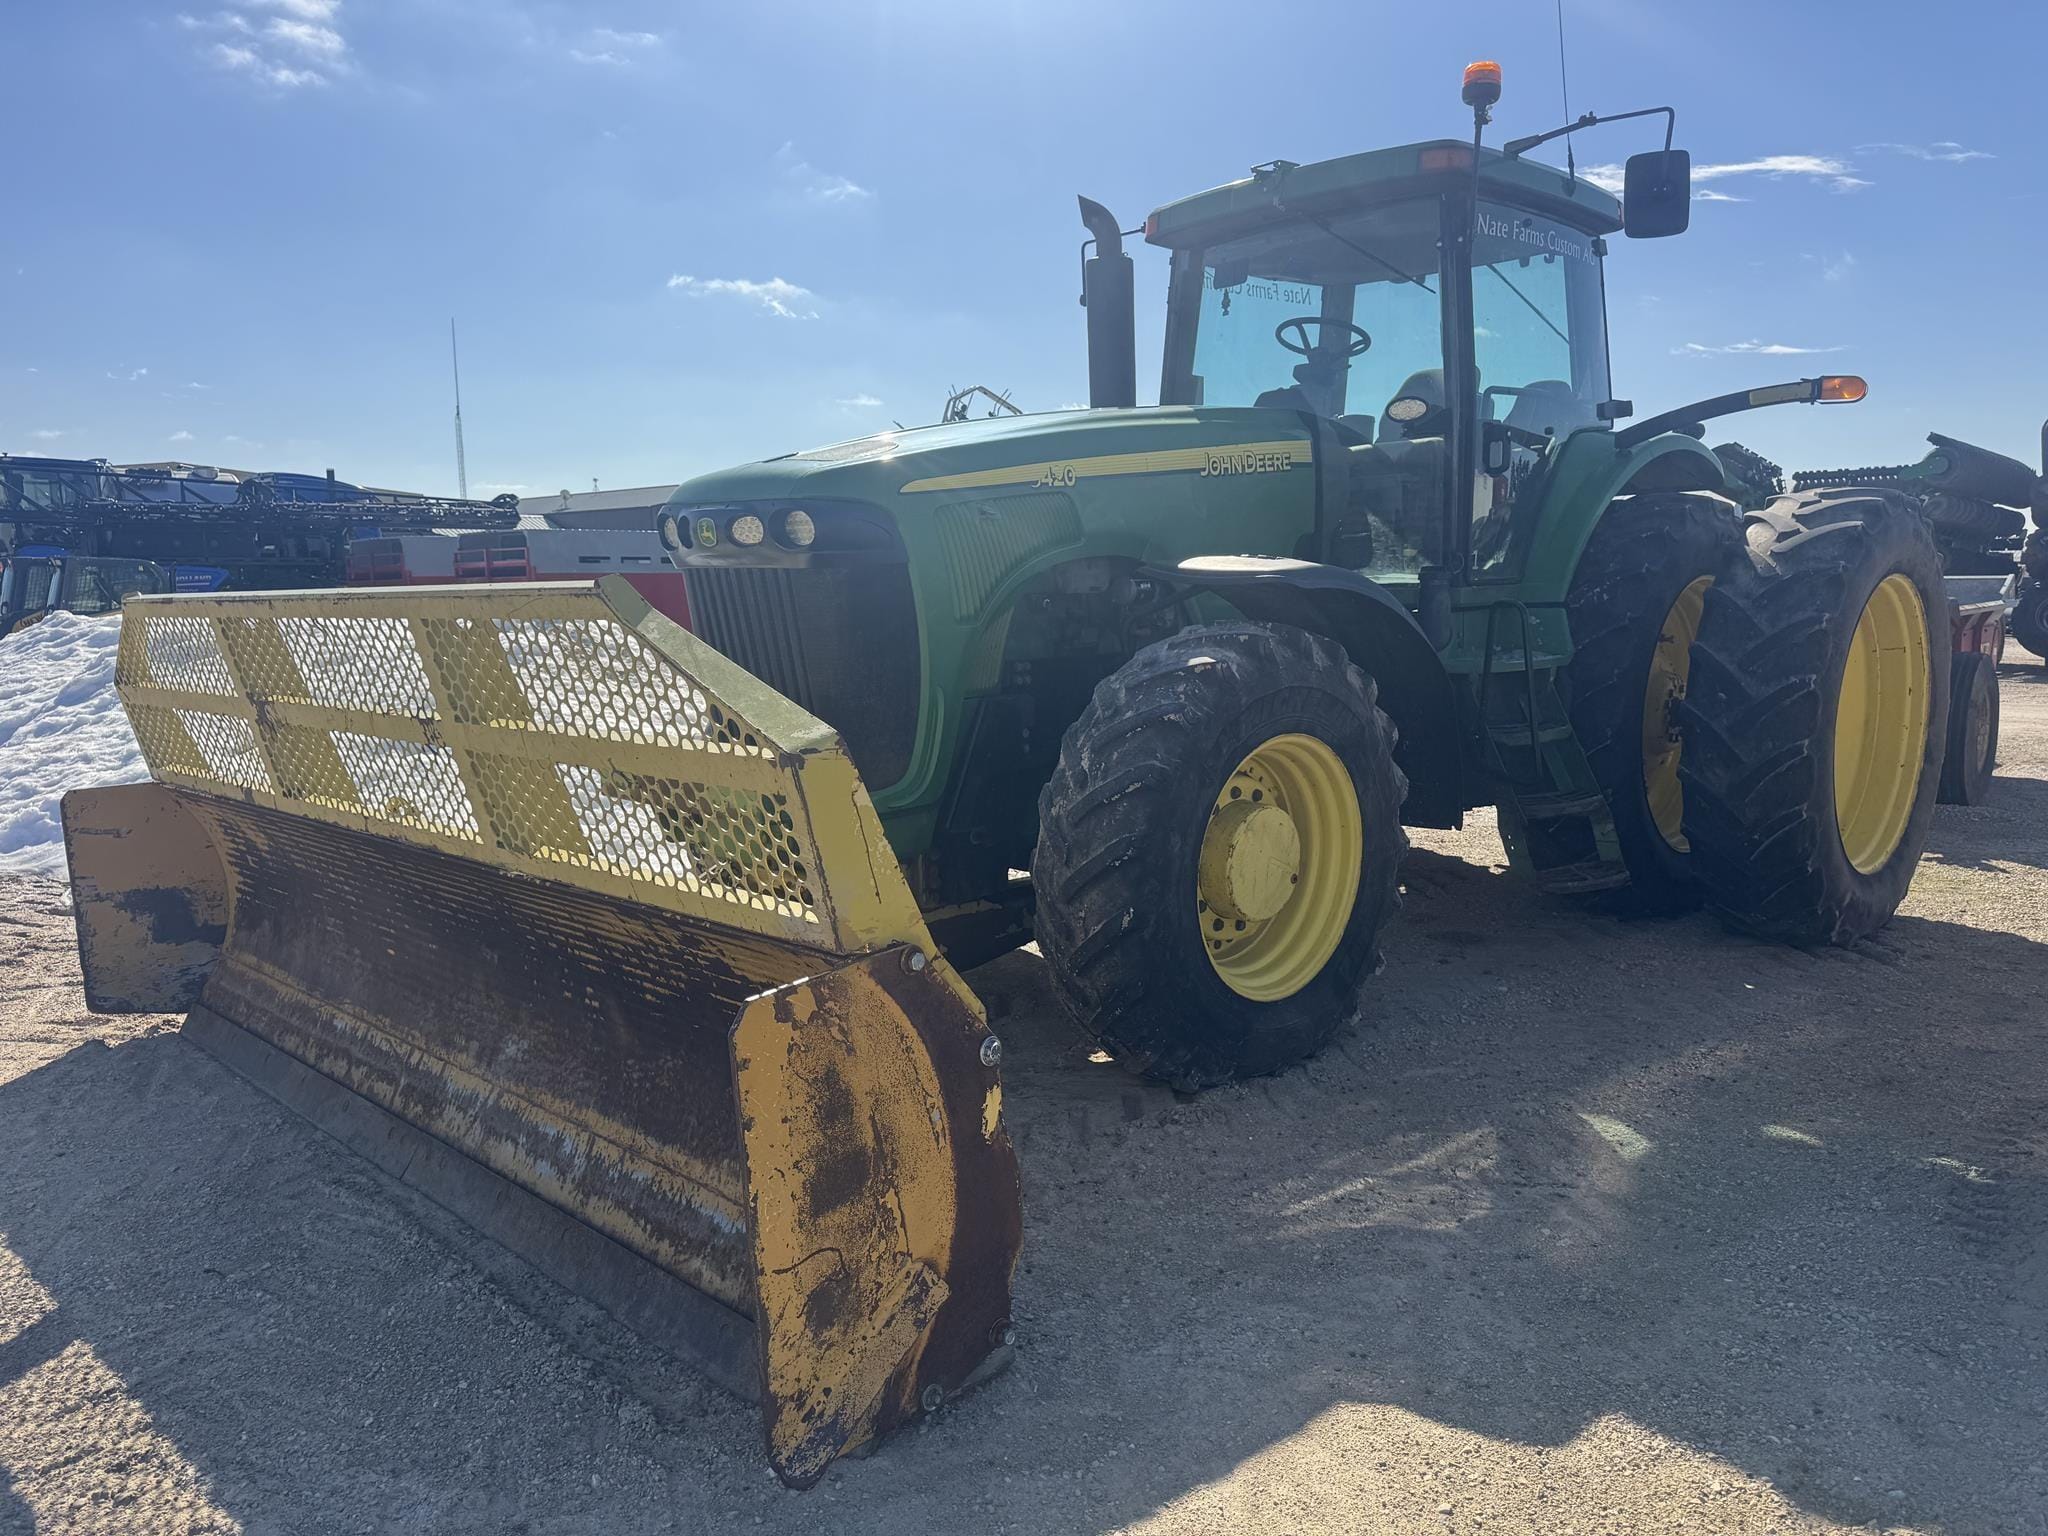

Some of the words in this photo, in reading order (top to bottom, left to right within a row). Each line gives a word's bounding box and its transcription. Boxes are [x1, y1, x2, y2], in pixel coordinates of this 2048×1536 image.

[1477, 213, 1509, 238] Nate
[1513, 219, 1545, 248] Farms
[1547, 231, 1581, 260] Custom
[1031, 465, 1077, 488] 420
[1200, 452, 1243, 477] JOHN
[1243, 450, 1292, 474] DEERE
